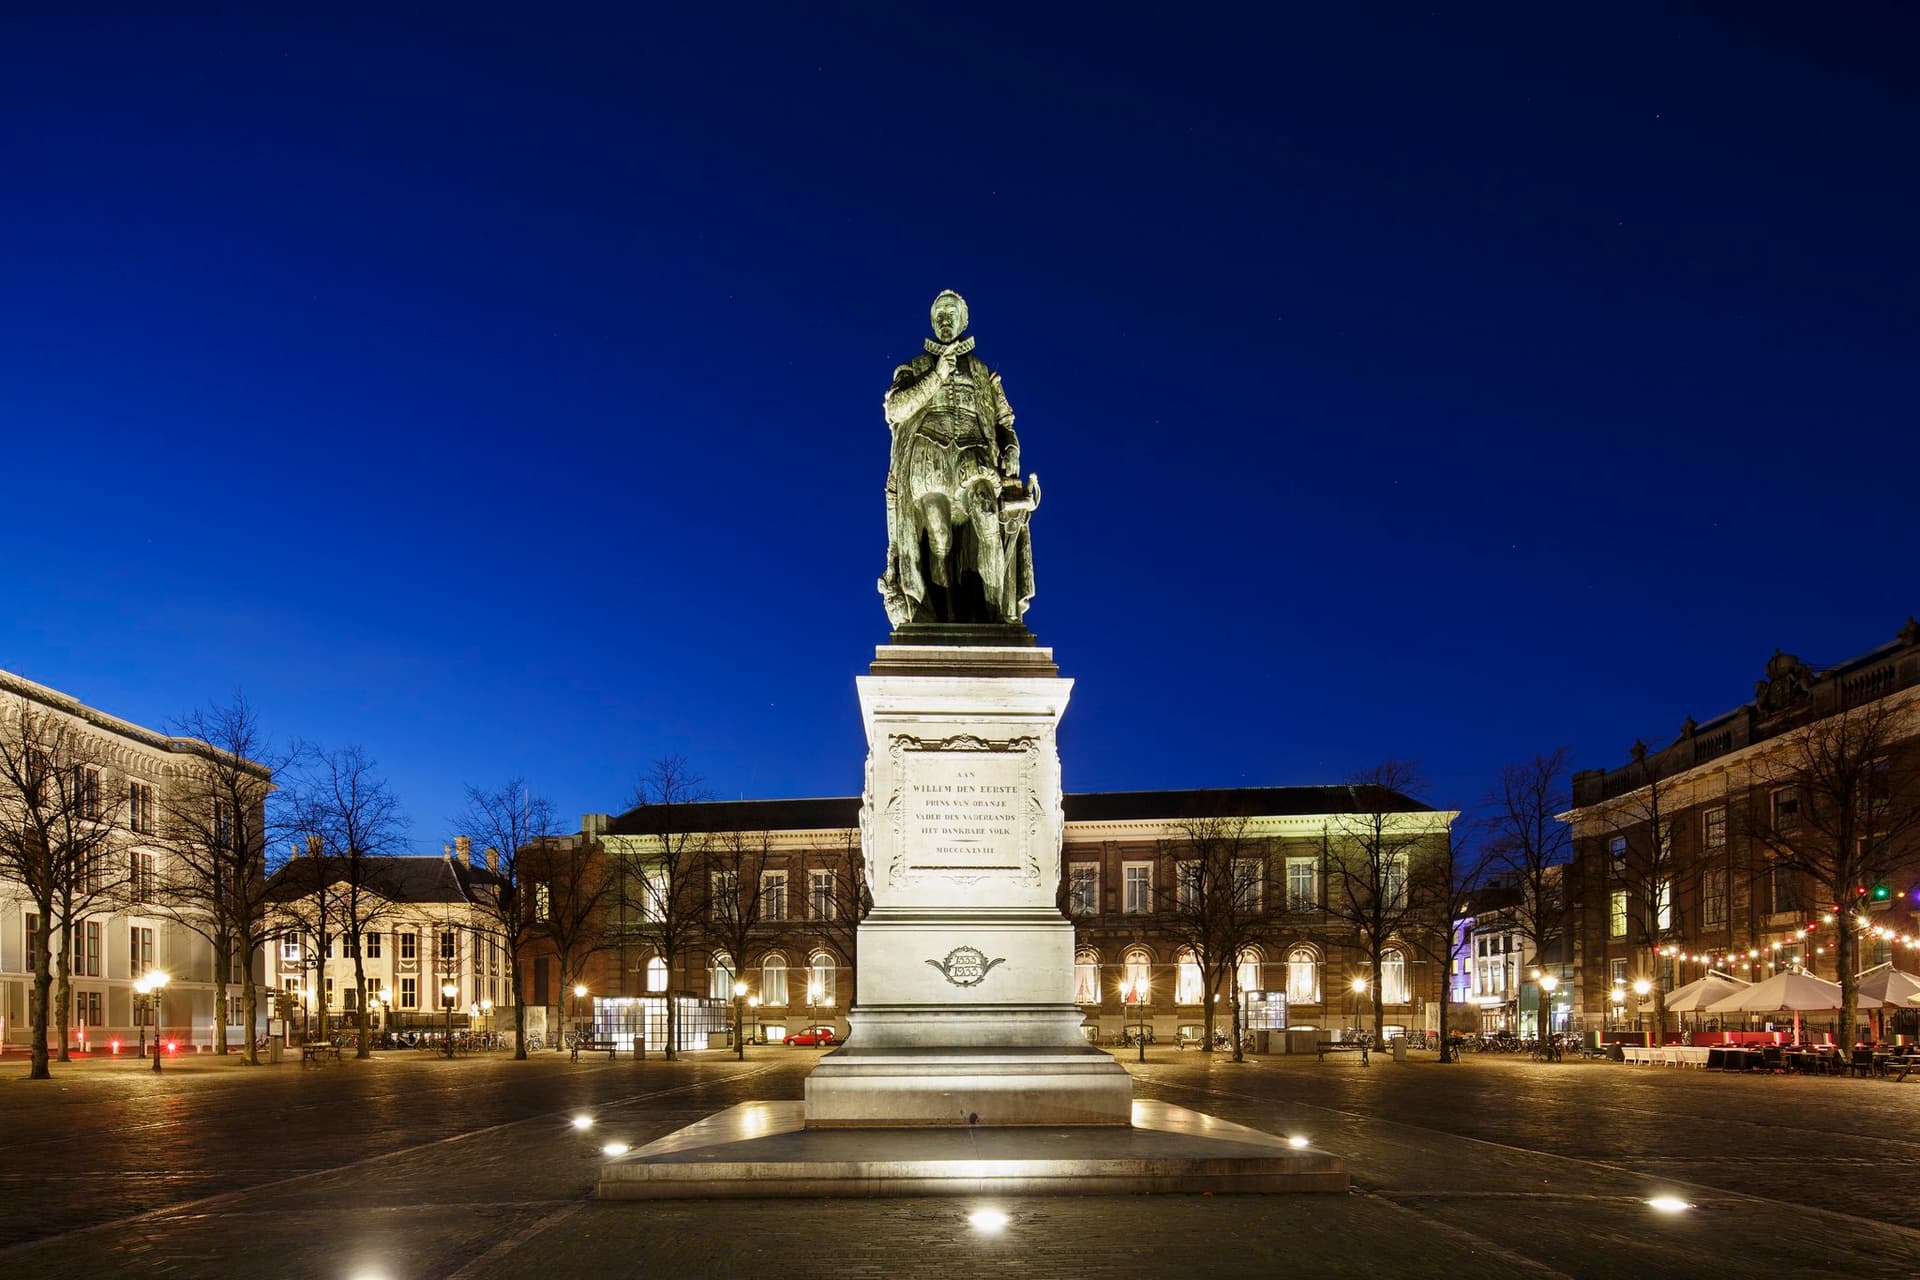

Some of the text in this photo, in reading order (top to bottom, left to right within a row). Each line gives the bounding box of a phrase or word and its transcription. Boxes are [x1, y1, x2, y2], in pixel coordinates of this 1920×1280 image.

[913, 784, 1018, 794] WILLEM DEN EERSTE
[973, 800, 1007, 808] ORANJE
[962, 813, 1016, 821] VADERLANDS
[942, 827, 985, 835] DANKBARE
[955, 956, 977, 965] 1533
[954, 966, 979, 977] 1933
